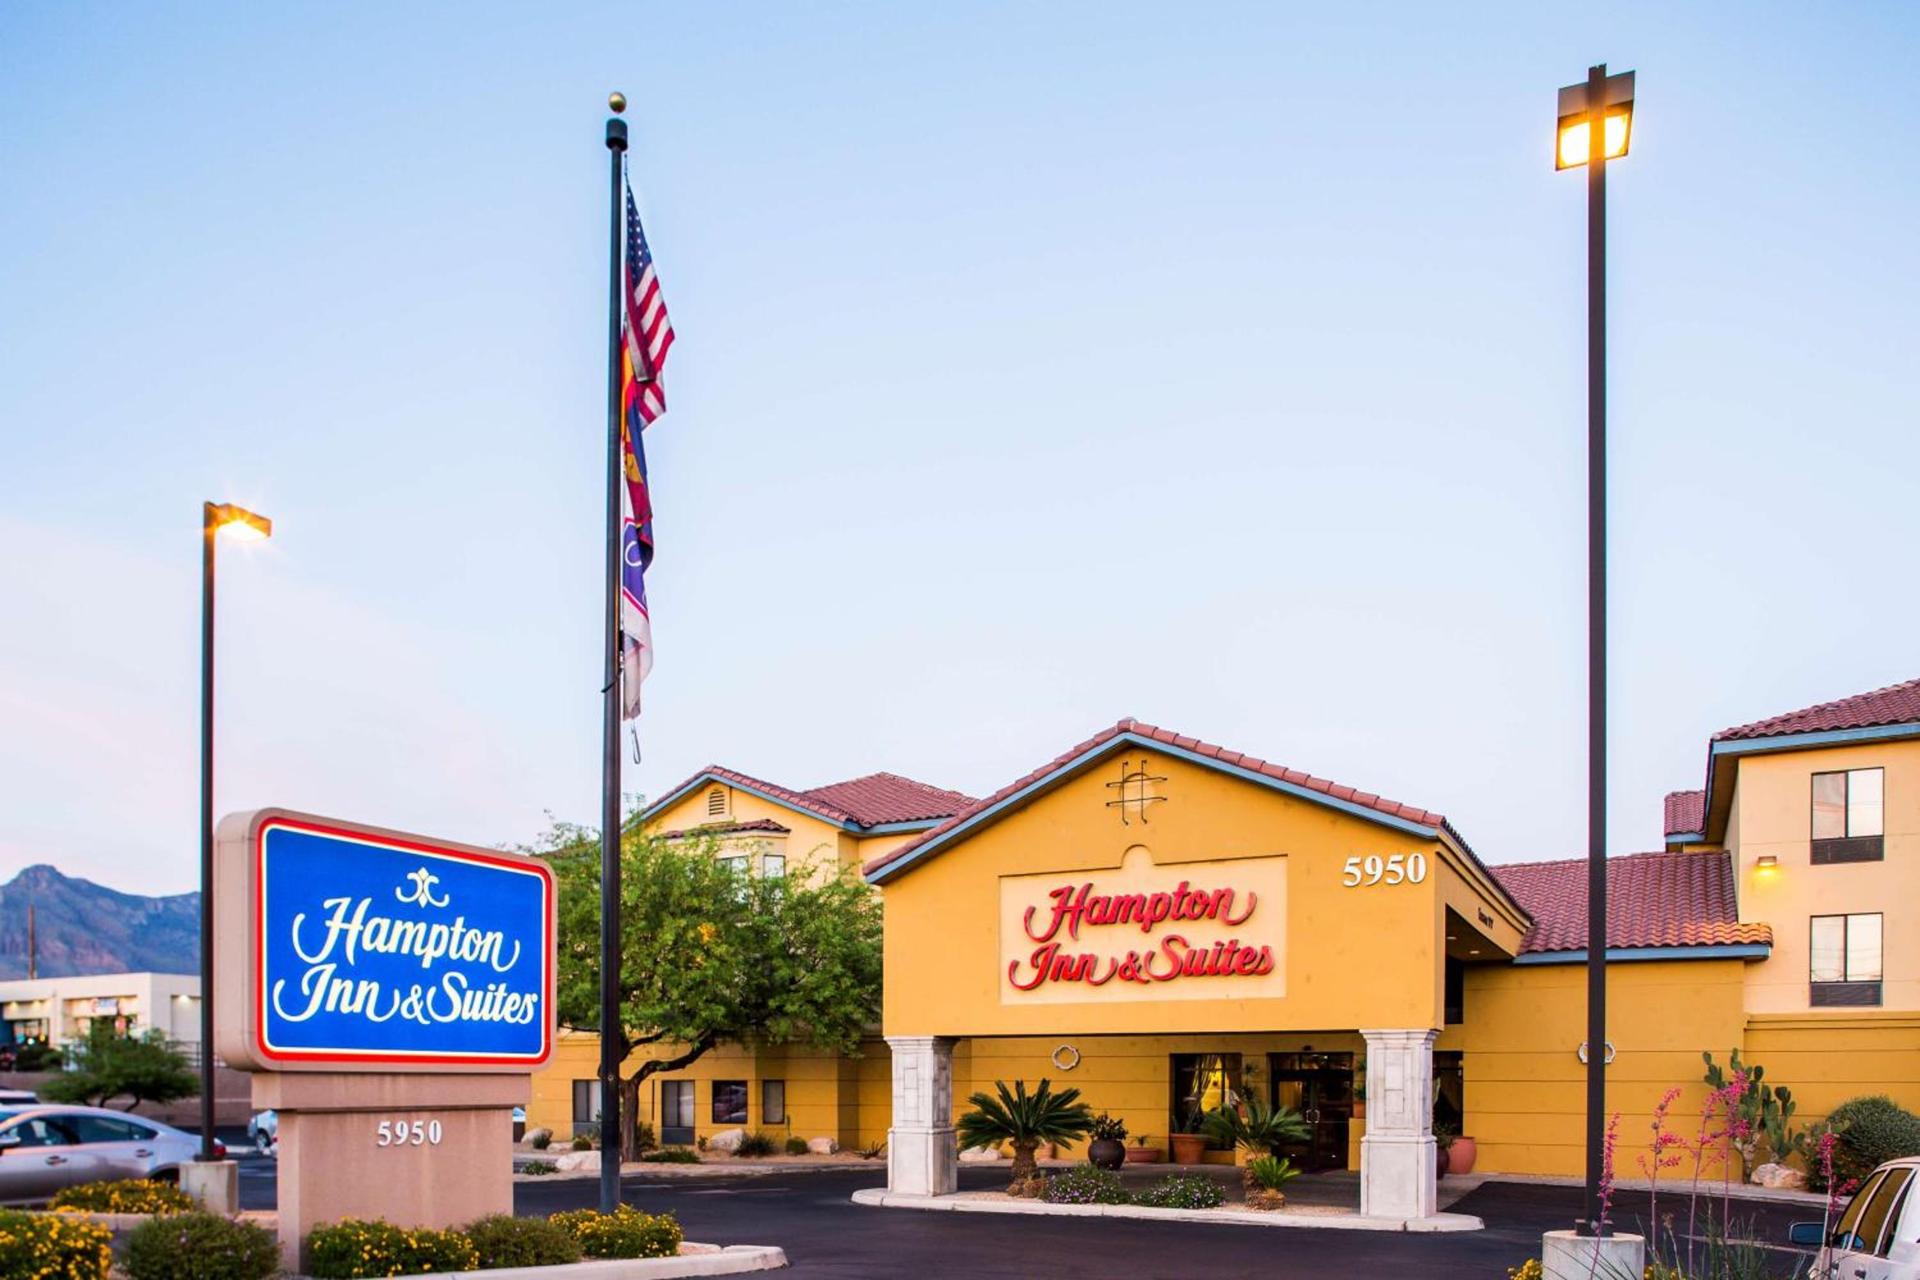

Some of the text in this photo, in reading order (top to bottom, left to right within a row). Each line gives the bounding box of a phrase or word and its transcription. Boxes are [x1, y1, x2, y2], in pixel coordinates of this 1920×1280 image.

[1343, 853, 1427, 887] 5950
[292, 897, 520, 972] Hampton
[1023, 880, 1258, 943] Hampton
[1008, 934, 1275, 991] Inn & Suites
[272, 963, 539, 1025] Inn & Suites
[377, 1119, 442, 1147] 5950
